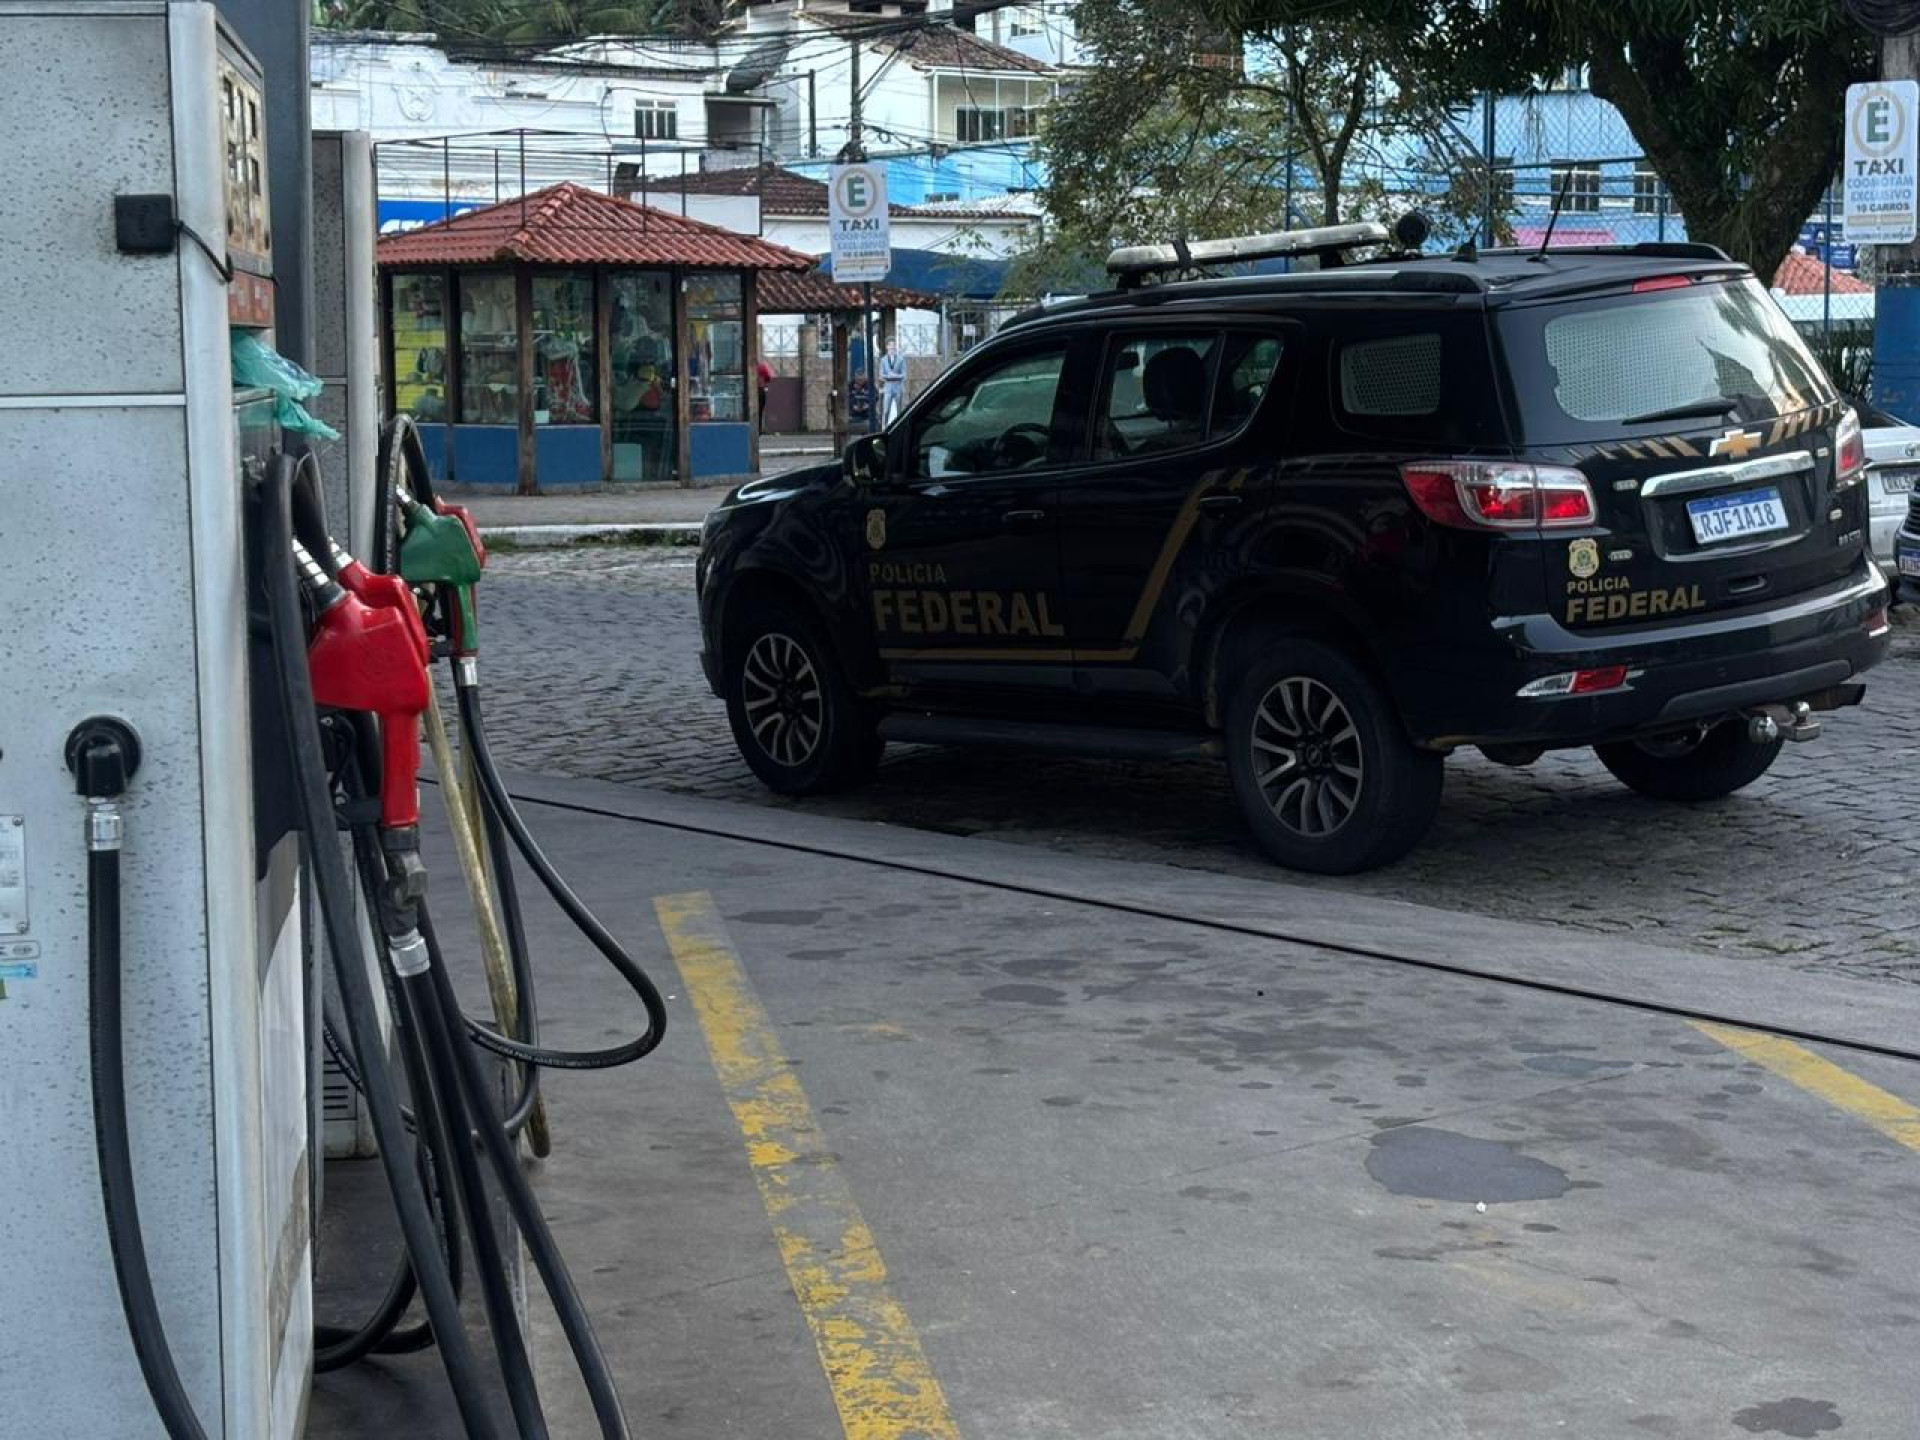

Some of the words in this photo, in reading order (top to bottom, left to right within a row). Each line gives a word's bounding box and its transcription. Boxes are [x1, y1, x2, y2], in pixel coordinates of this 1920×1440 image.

[1866, 101, 1889, 142] E
[1854, 158, 1904, 175] TAXI
[847, 176, 866, 207] E
[1870, 203, 1910, 212] CARROS
[840, 218, 880, 231] TAXI
[1700, 502, 1777, 537] RJF1A18
[1567, 575, 1630, 595] POLICIA
[873, 590, 1065, 637] FEDERAL
[1566, 584, 1706, 623] FEDERAL
